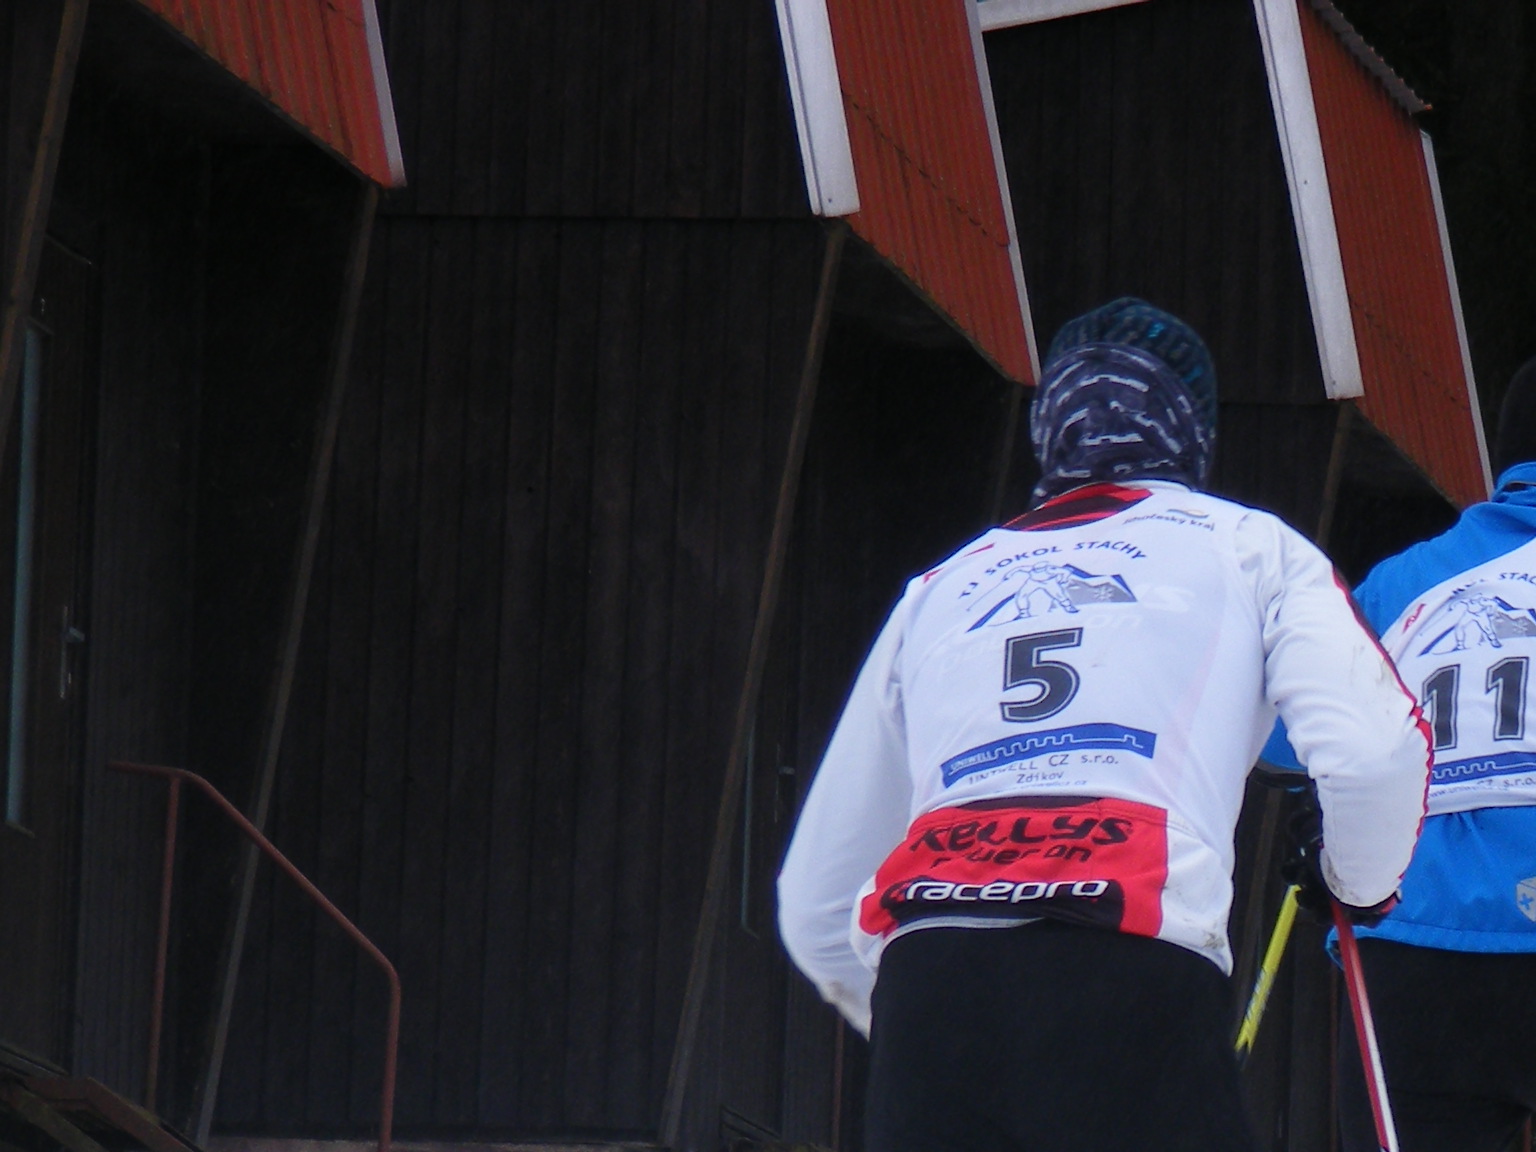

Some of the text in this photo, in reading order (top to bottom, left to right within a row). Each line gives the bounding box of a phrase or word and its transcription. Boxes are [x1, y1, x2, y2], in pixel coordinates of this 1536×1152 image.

[985, 545, 1063, 576] SOKOL
[1073, 540, 1147, 560] STACHY
[1000, 627, 1083, 723] 5
[1420, 656, 1530, 751] 11
[1048, 754, 1070, 768] CZ
[1080, 753, 1119, 765] s.r.o.
[905, 879, 1108, 904] racepro
